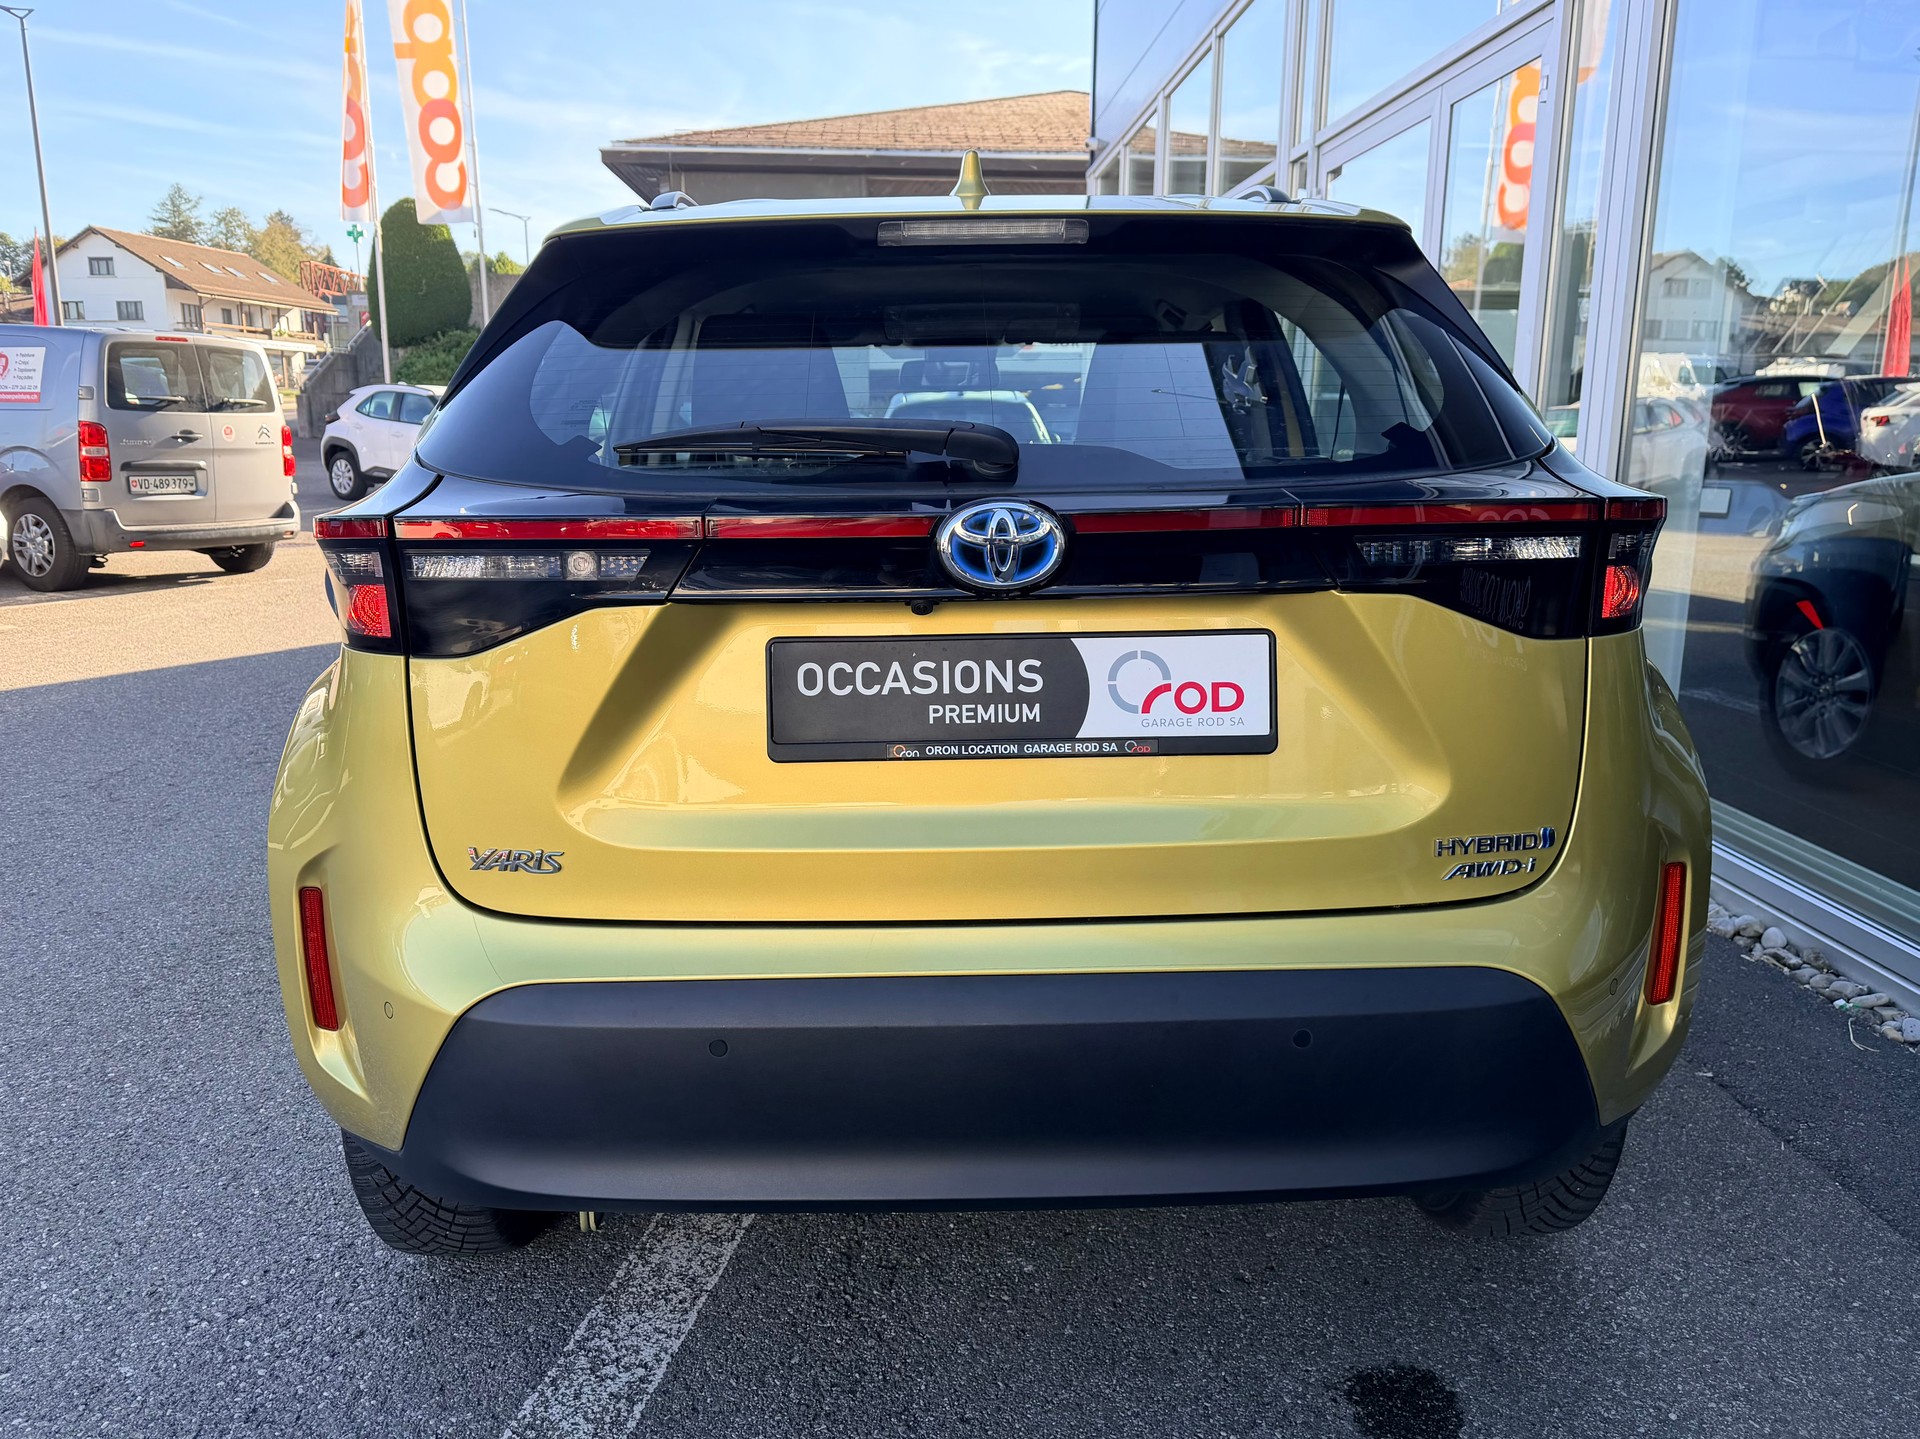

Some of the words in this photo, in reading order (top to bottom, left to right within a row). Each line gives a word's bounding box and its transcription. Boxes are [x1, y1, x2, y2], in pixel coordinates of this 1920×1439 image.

[394, 0, 467, 210] coop
[797, 659, 1044, 697] OCCASIONS
[929, 703, 1041, 724] PREMIUM
[1141, 718, 1193, 728] GARAGE
[1197, 717, 1225, 727] ROD
[1230, 717, 1245, 726] SA
[925, 745, 958, 755] ORON
[961, 744, 1018, 755] LOCATION
[1024, 743, 1072, 753] GARAGE
[1075, 742, 1099, 753] ROD
[1102, 742, 1118, 752] SA
[1434, 833, 1538, 857] HYBRID
[467, 846, 565, 875] YARIS
[1441, 857, 1537, 880] AWD-i
